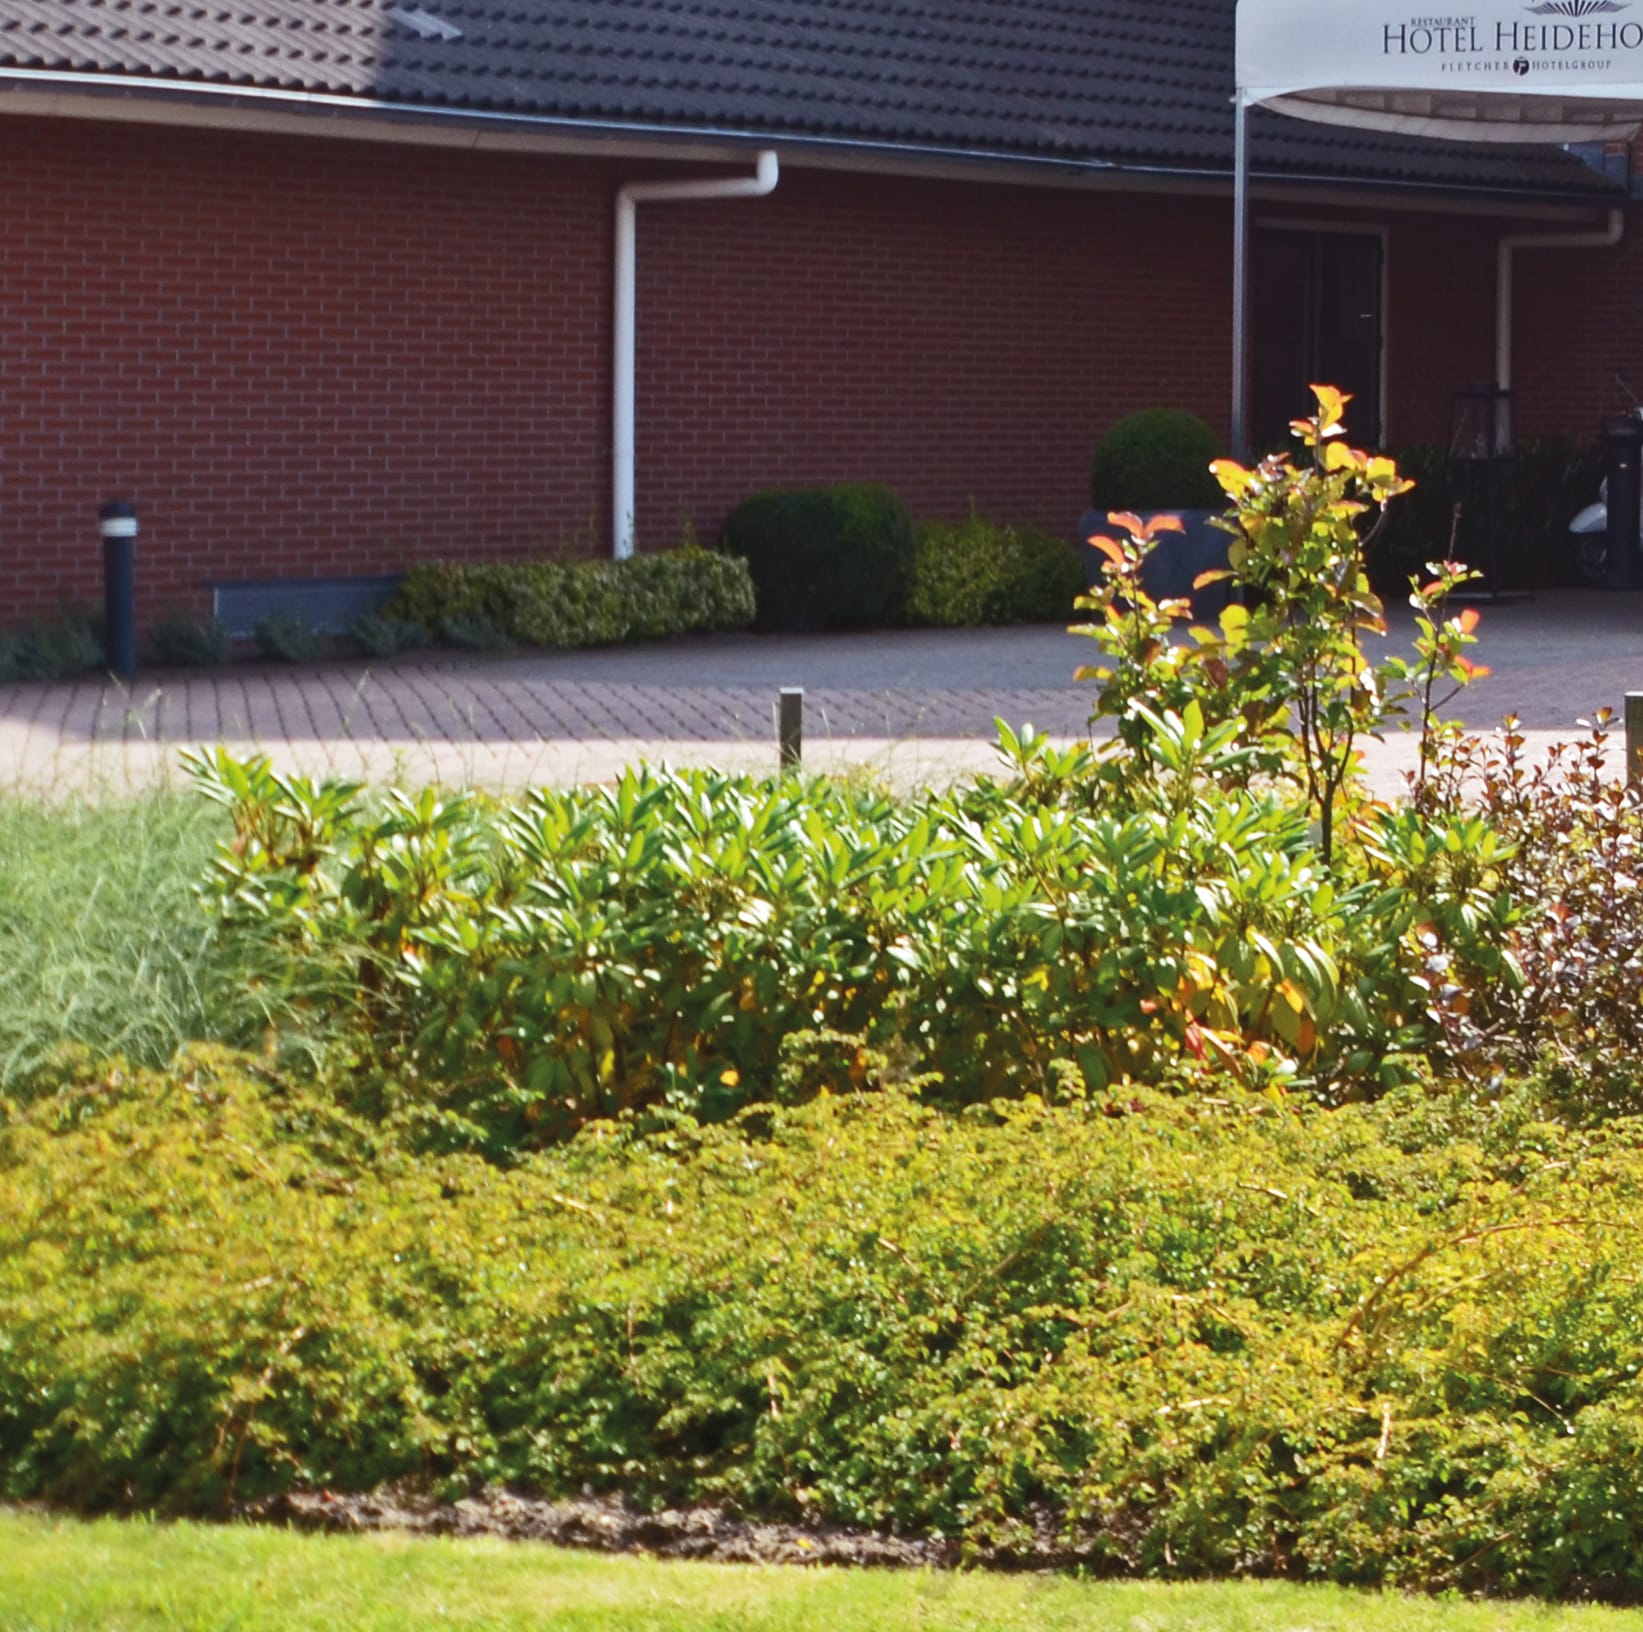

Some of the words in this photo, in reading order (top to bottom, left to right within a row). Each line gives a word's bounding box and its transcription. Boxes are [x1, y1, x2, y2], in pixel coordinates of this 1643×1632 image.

[1410, 16, 1476, 27] RESTAURANT
[1383, 23, 1483, 54] HOTEL
[1441, 61, 1510, 72] FLETCHER
[1531, 60, 1612, 71] HOTELGROUP
